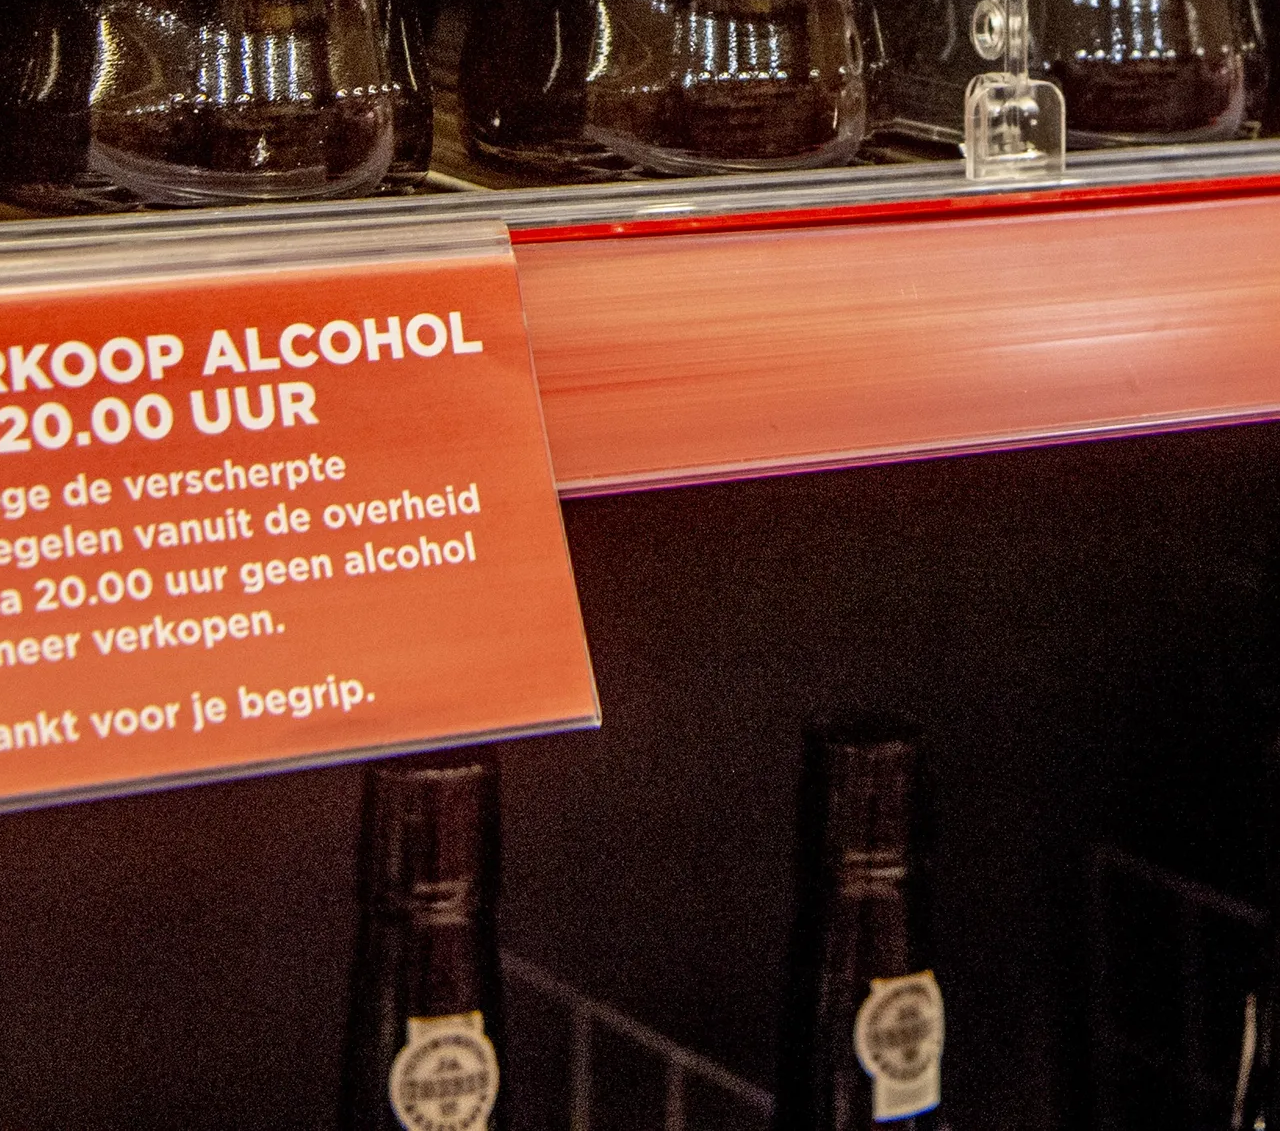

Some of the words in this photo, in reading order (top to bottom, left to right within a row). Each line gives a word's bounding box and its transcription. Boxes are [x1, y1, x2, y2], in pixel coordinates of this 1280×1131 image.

[202, 311, 484, 377] ALCOHOL
[191, 380, 320, 435] UUR
[63, 472, 113, 506] de
[123, 452, 348, 504] verscherpte
[133, 509, 254, 551] vanuit
[263, 503, 311, 537] de
[322, 483, 482, 530] overheid
[34, 570, 153, 613] 20.00
[166, 567, 230, 597] uur
[240, 552, 333, 594] geen
[346, 529, 478, 577] alcohol
[92, 605, 287, 657] verkopen.
[92, 699, 180, 736] voor
[191, 689, 229, 733] je
[238, 674, 377, 721] begrip.
